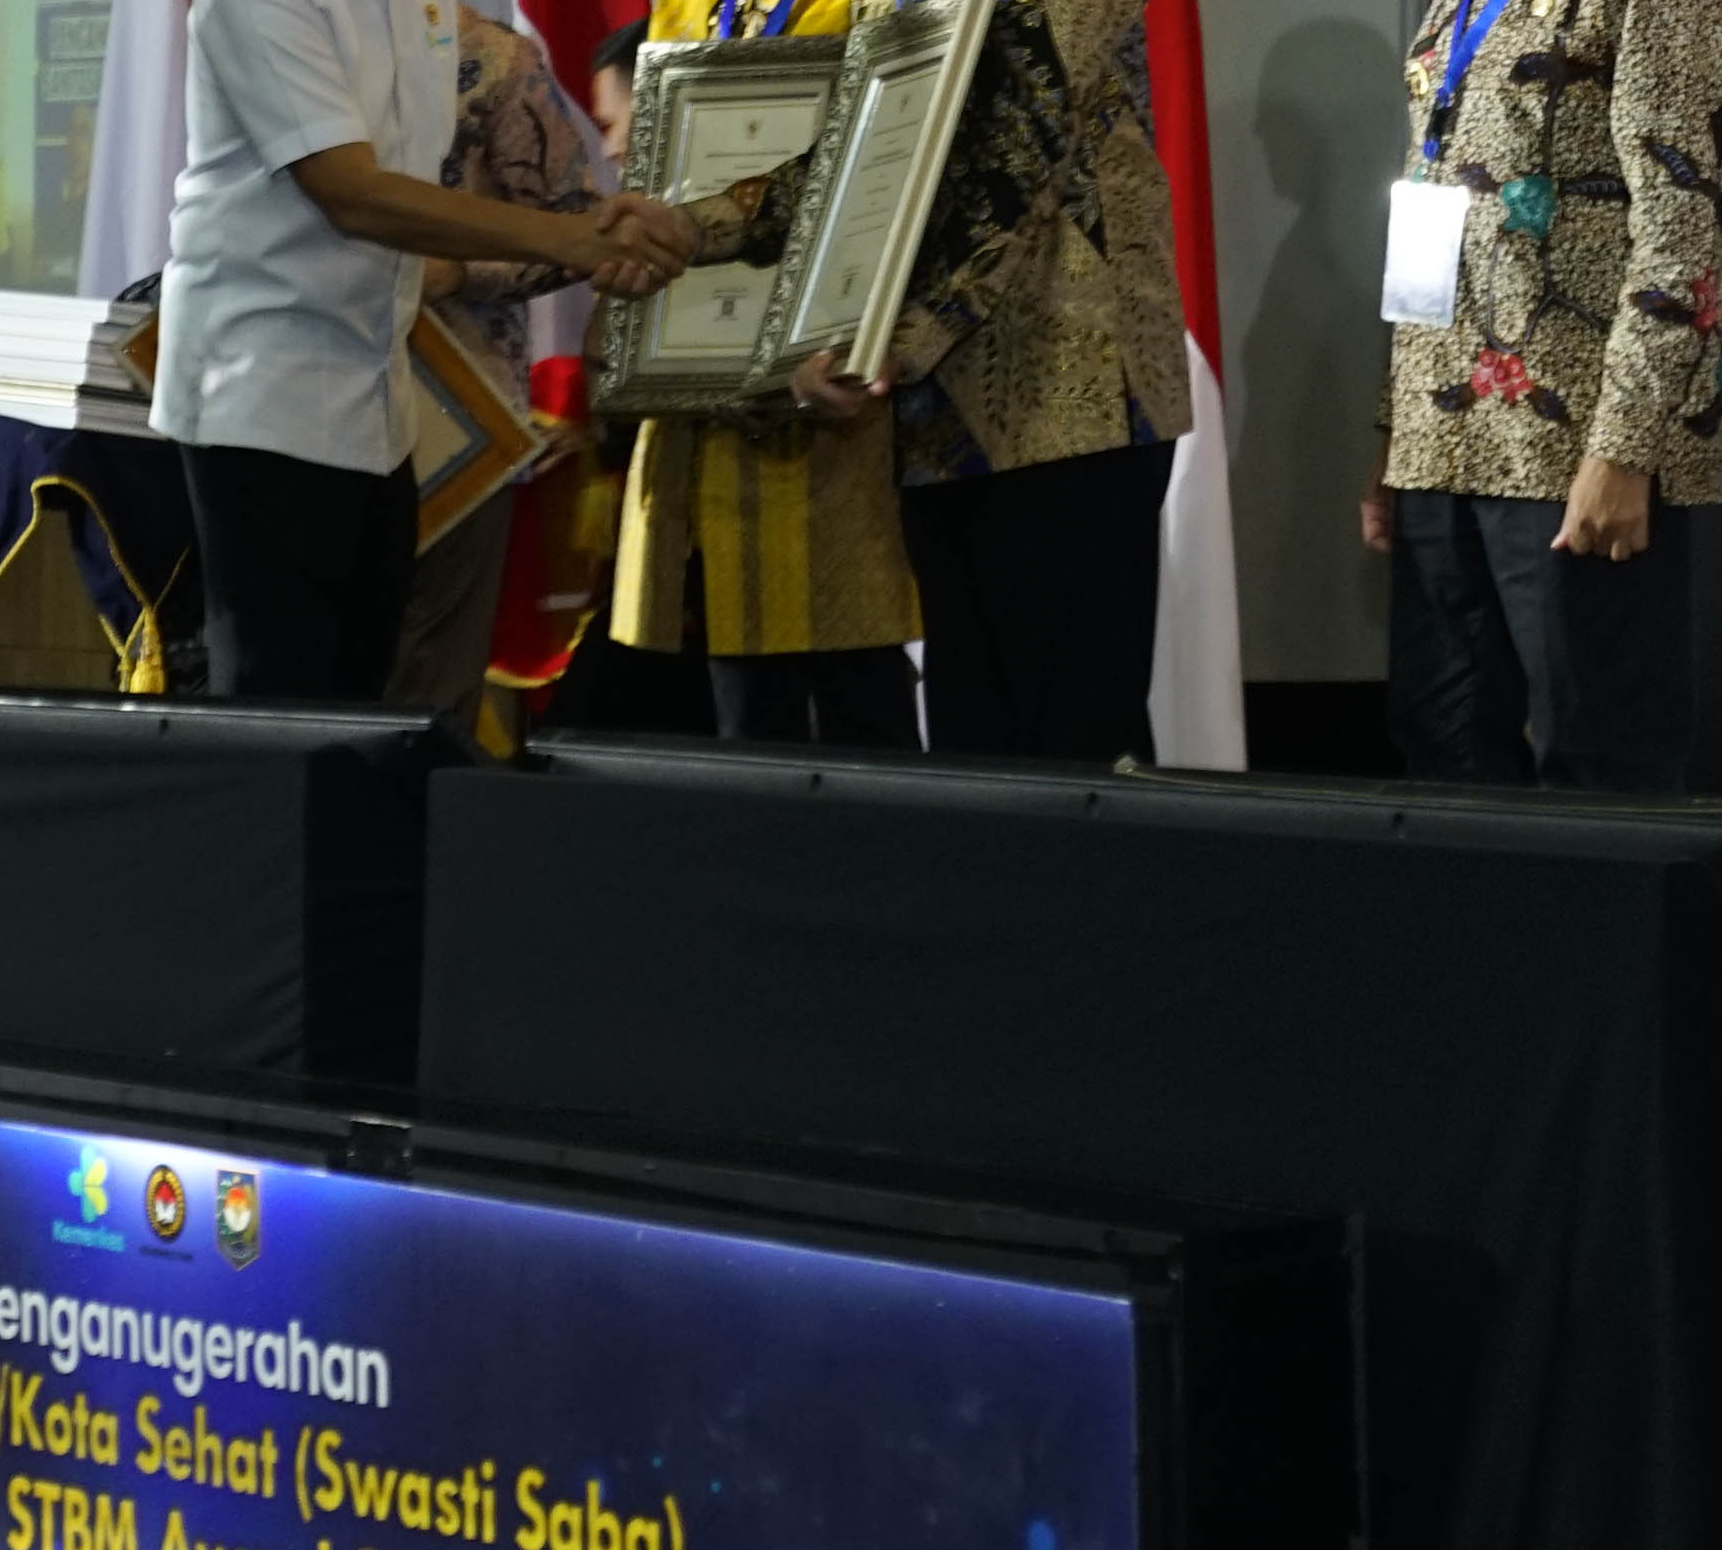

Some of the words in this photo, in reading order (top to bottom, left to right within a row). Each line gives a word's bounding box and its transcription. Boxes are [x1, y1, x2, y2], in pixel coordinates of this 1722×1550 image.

[5, 1474, 138, 1550] STBM
[135, 1395, 278, 1499] Sehat
[295, 1426, 496, 1545] (Swasti
